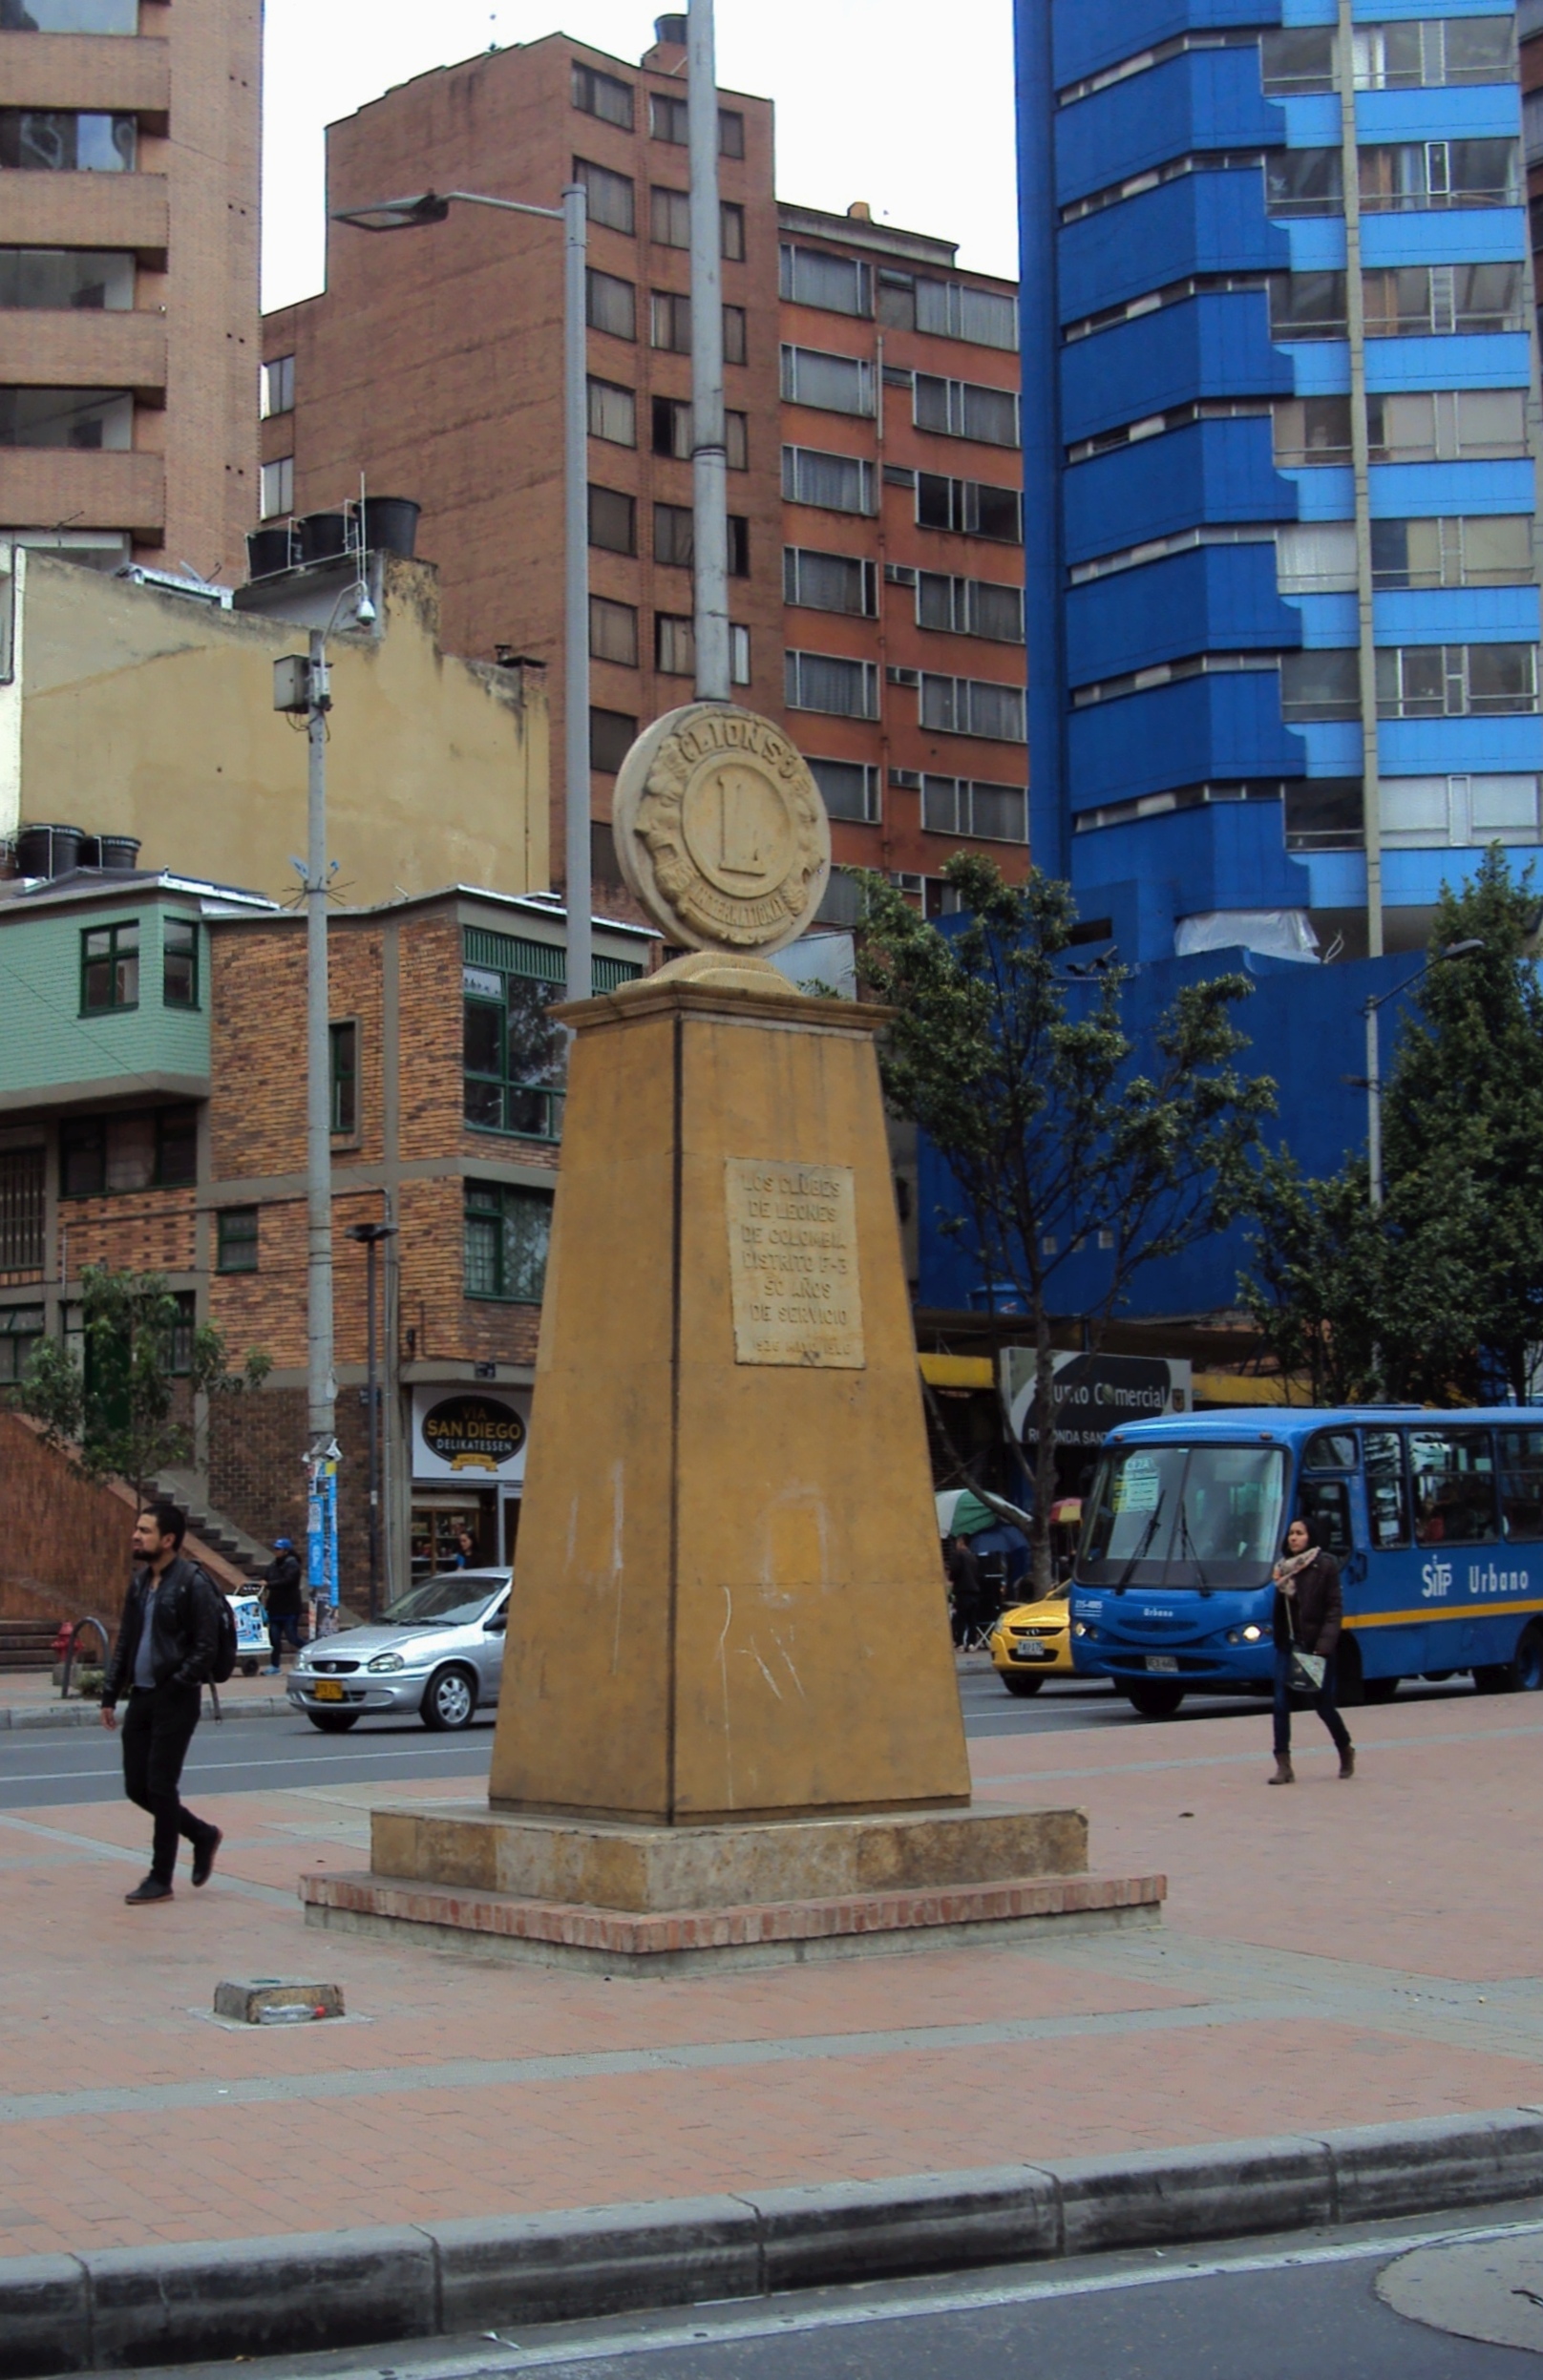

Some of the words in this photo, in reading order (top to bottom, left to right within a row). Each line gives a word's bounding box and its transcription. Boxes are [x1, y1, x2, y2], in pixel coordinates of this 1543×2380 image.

[741, 1173, 774, 1193] LOS
[779, 1175, 841, 1198] CLUBES
[749, 1200, 771, 1218] DE
[776, 1203, 837, 1223] LEONES
[741, 1225, 763, 1243] DE
[769, 1229, 847, 1250] COLOMBIA
[742, 1250, 814, 1273] DISTRITO
[791, 1277, 832, 1299] AÑOS
[750, 1303, 772, 1321] DE
[778, 1306, 848, 1326] SERVICIO
[427, 1420, 463, 1437] SAN
[467, 1421, 521, 1440] DIEGO
[436, 1439, 512, 1451] DELIKATESSEN
[1469, 1563, 1529, 1594] Urbano
[1144, 1607, 1174, 1617] Urbano
